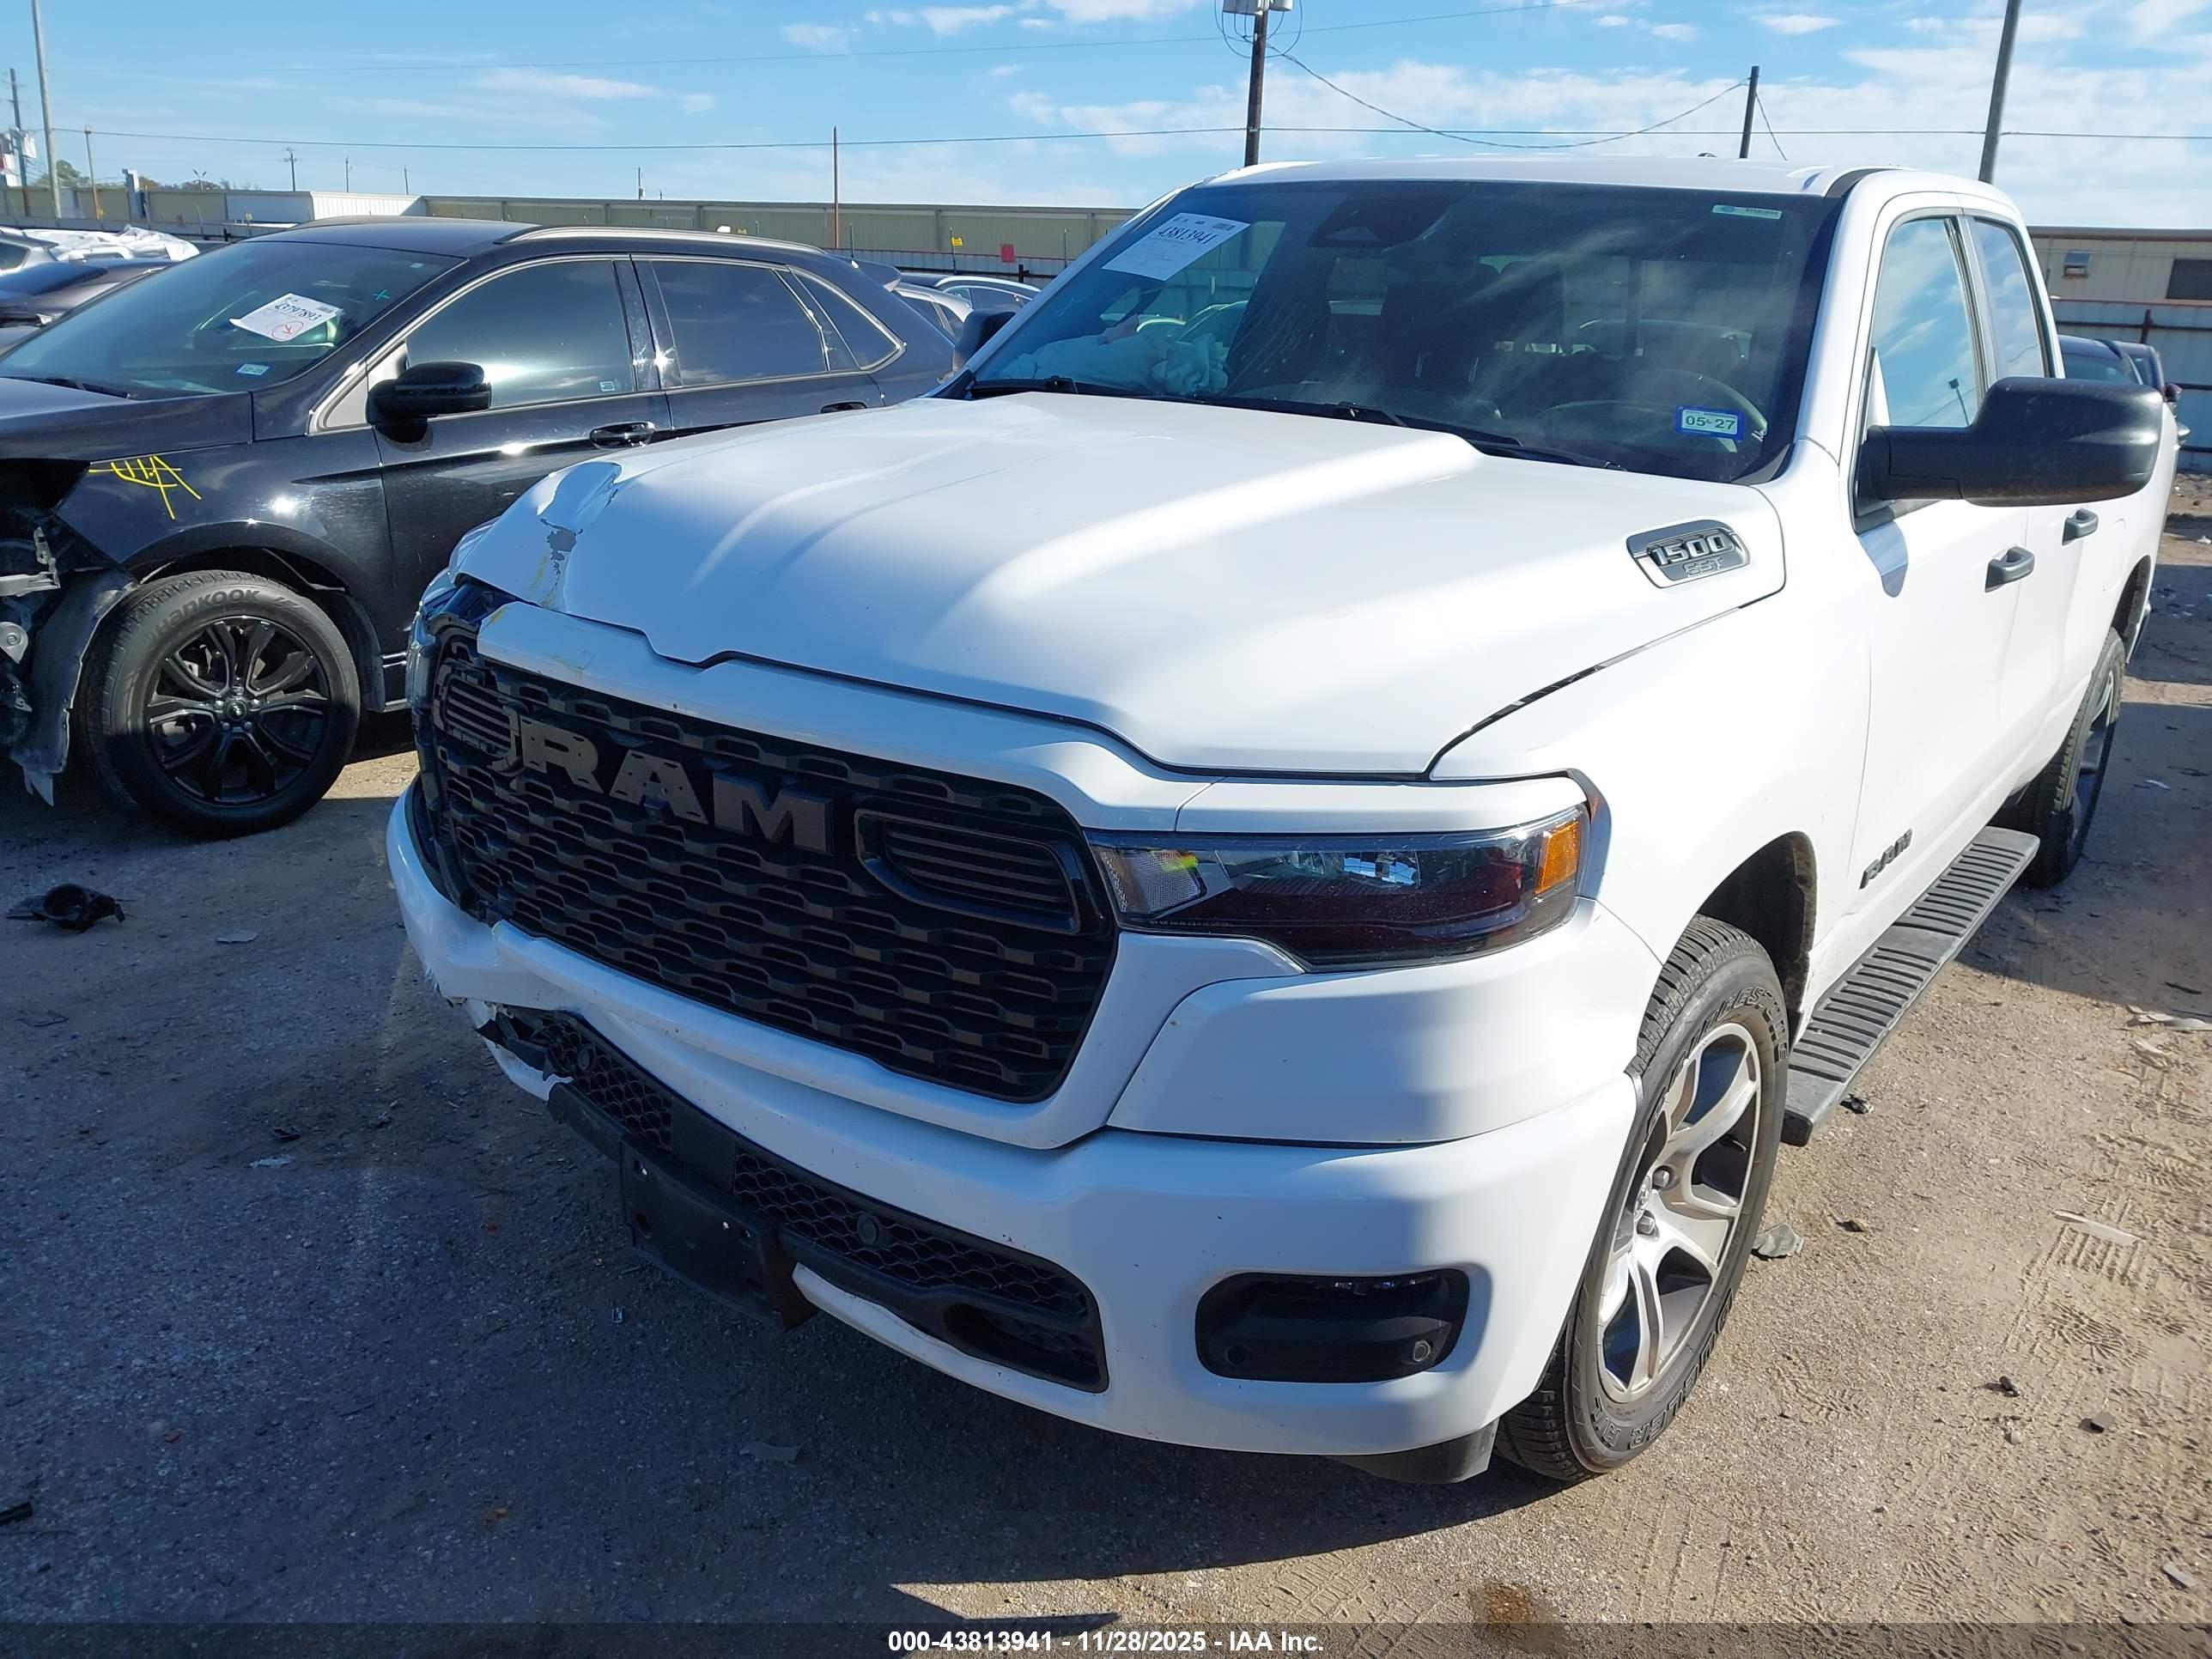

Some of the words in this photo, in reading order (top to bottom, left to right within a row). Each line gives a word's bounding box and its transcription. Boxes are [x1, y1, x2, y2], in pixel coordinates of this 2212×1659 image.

[1158, 226, 1218, 245] 43813941
[275, 301, 324, 321] 43797893
[1686, 415, 1736, 429] 05-27
[1653, 534, 1726, 566] 1500
[520, 714, 836, 857] RAM
[1859, 828, 1913, 890] RAM
